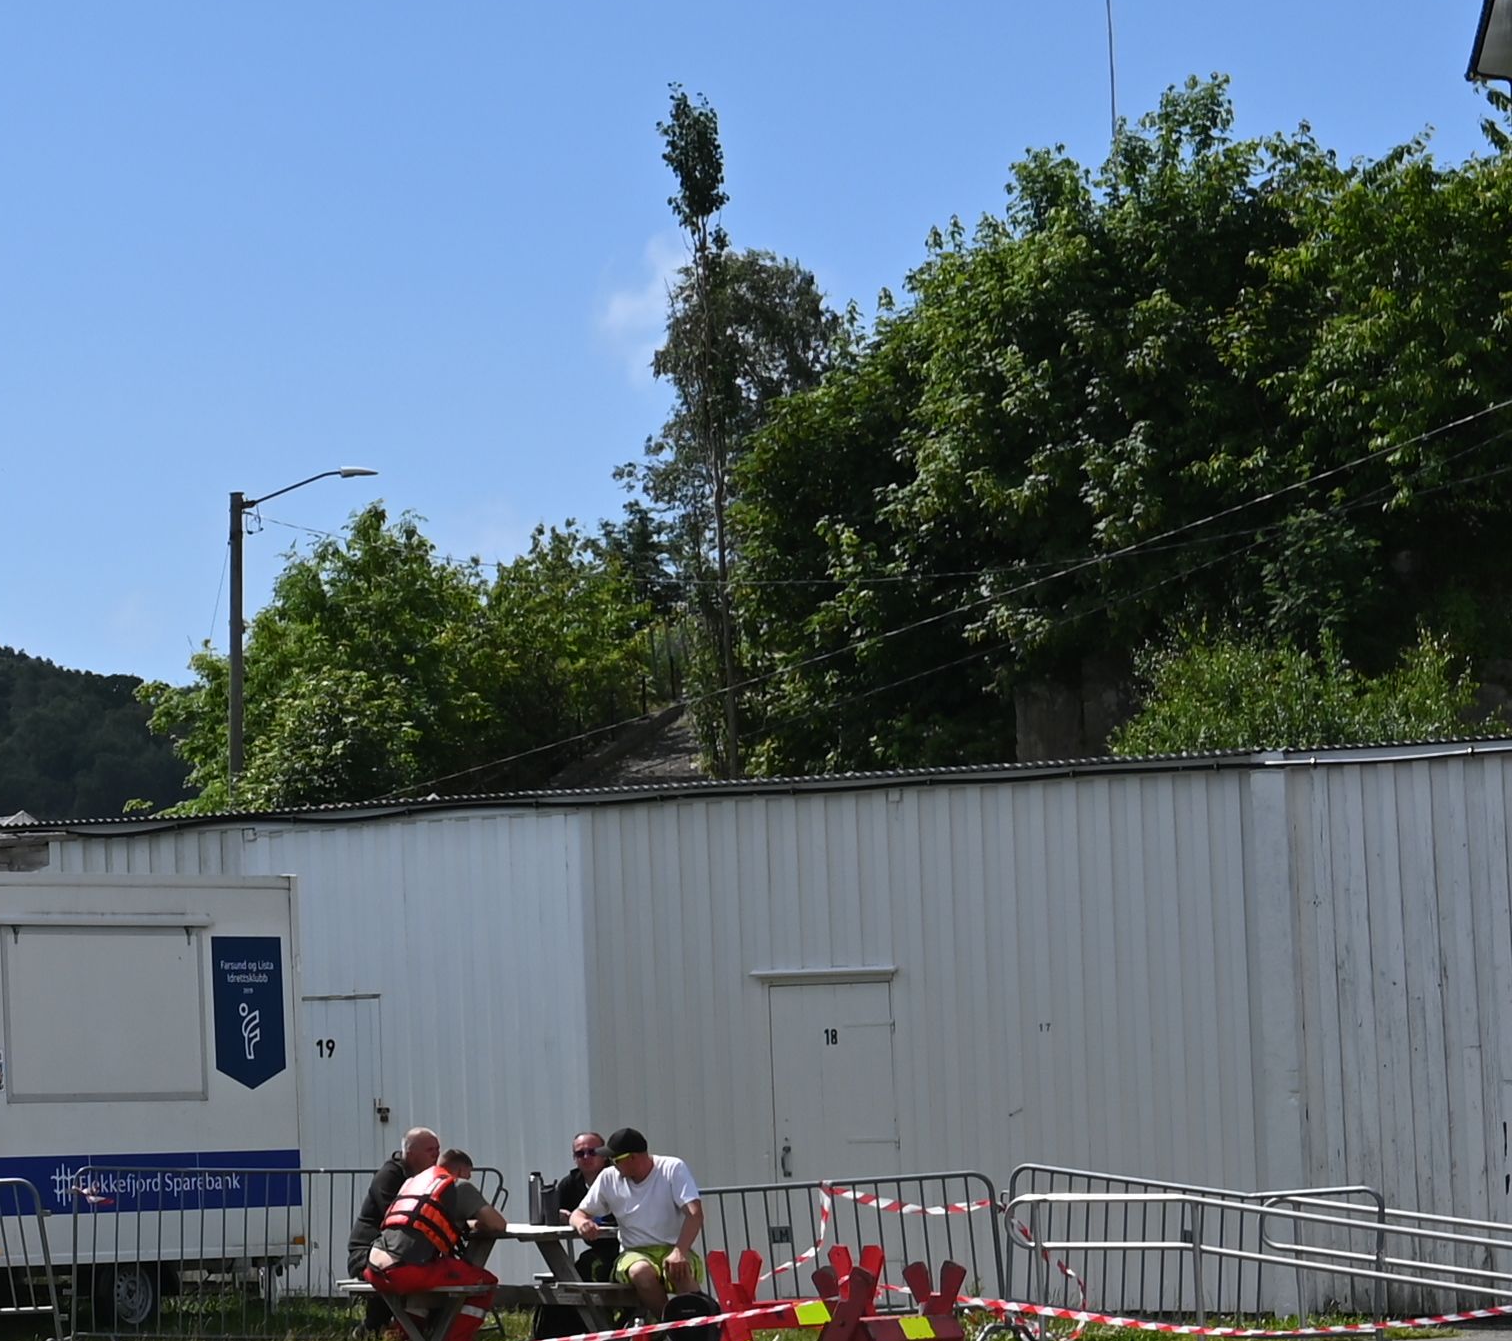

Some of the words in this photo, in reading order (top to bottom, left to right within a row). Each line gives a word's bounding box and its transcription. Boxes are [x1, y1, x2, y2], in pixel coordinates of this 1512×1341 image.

[220, 959, 247, 970] Farsund
[247, 962, 257, 972] og
[258, 959, 274, 970] Lista
[226, 973, 269, 983] Idrettsklubb
[1038, 1023, 1051, 1032] 17
[824, 1028, 838, 1045] 18
[316, 1039, 335, 1058] 19
[79, 1172, 161, 1198] Flekkefjord
[165, 1172, 240, 1197] Sparebank
[772, 1229, 790, 1242] LM
